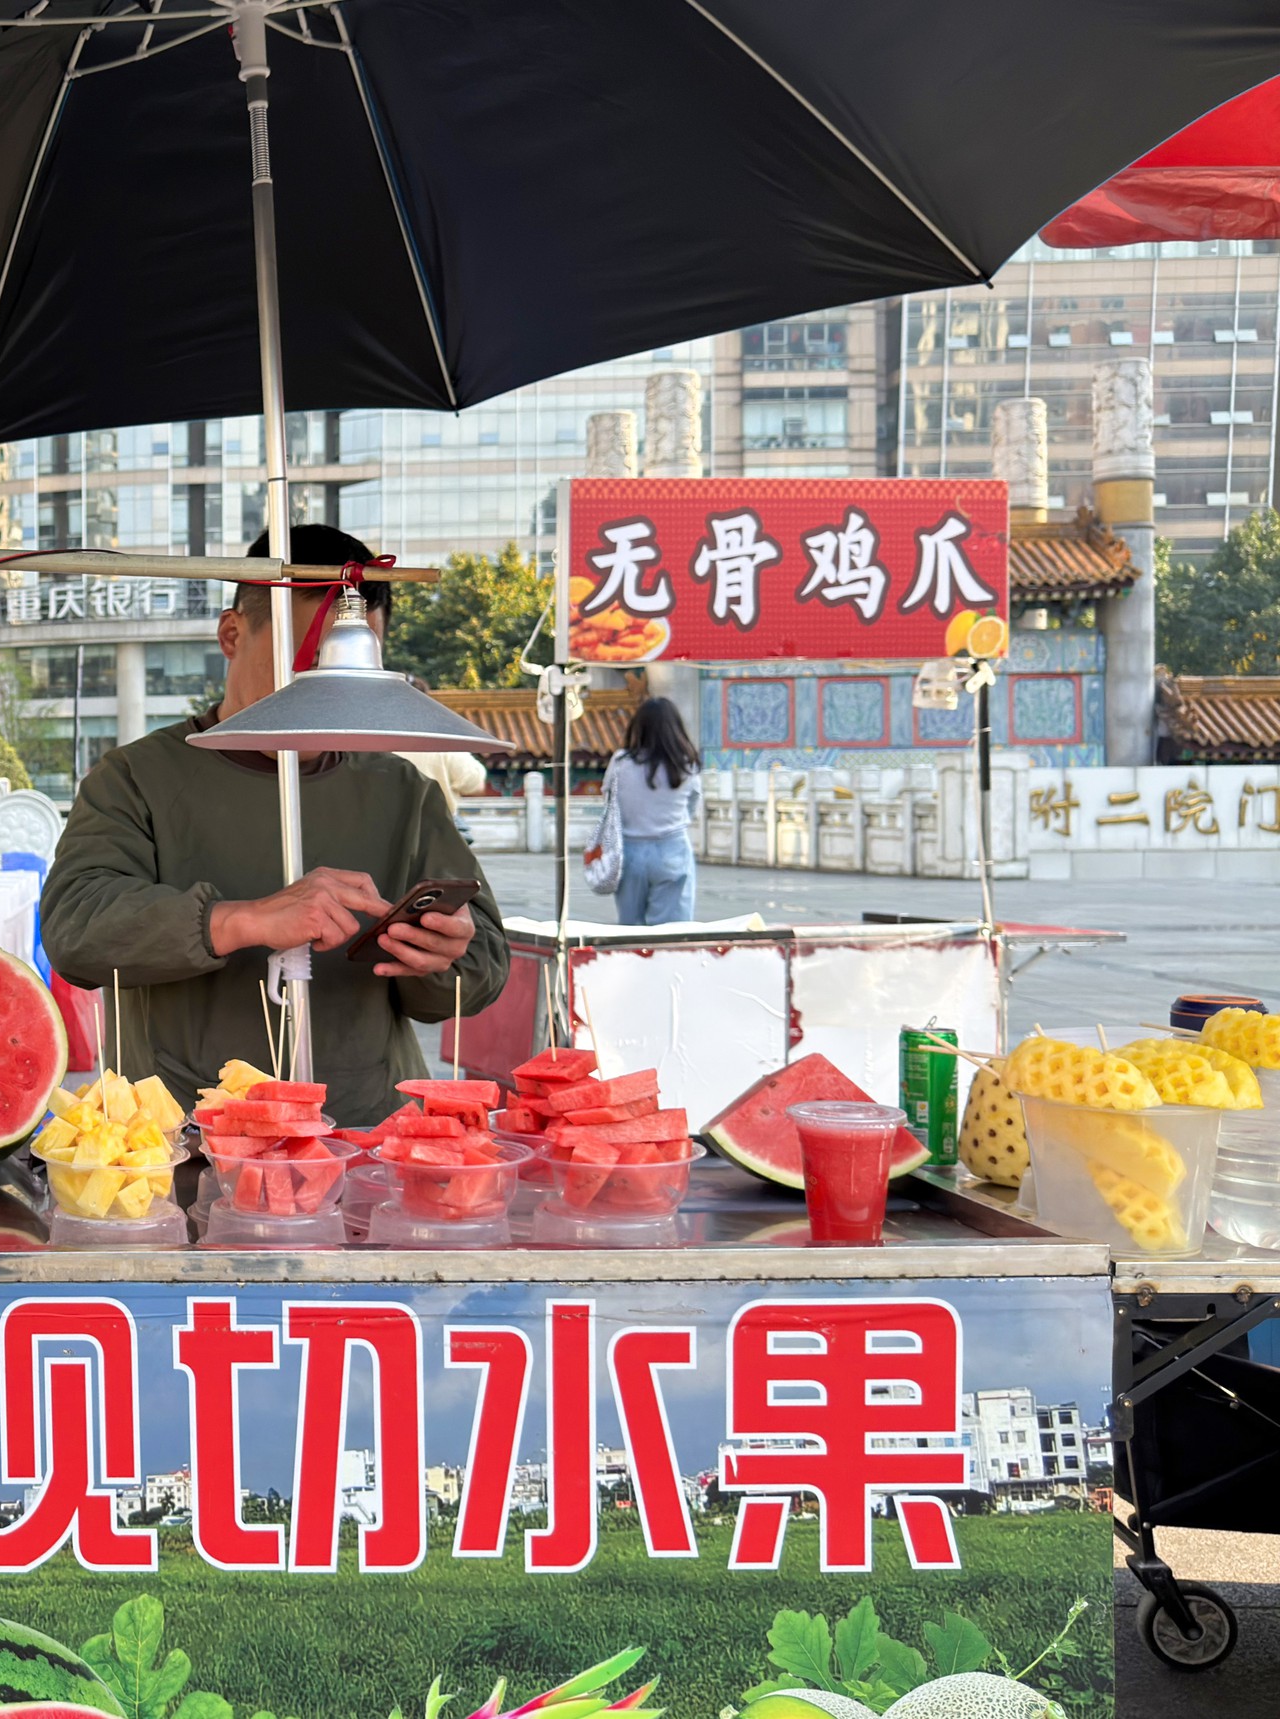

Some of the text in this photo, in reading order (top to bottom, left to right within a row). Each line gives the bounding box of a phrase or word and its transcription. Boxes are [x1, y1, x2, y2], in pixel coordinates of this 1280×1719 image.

[583, 508, 996, 628] 无骨鸡爪
[6, 580, 180, 623] 重庆银行
[1030, 779, 1280, 837] 附二院门
